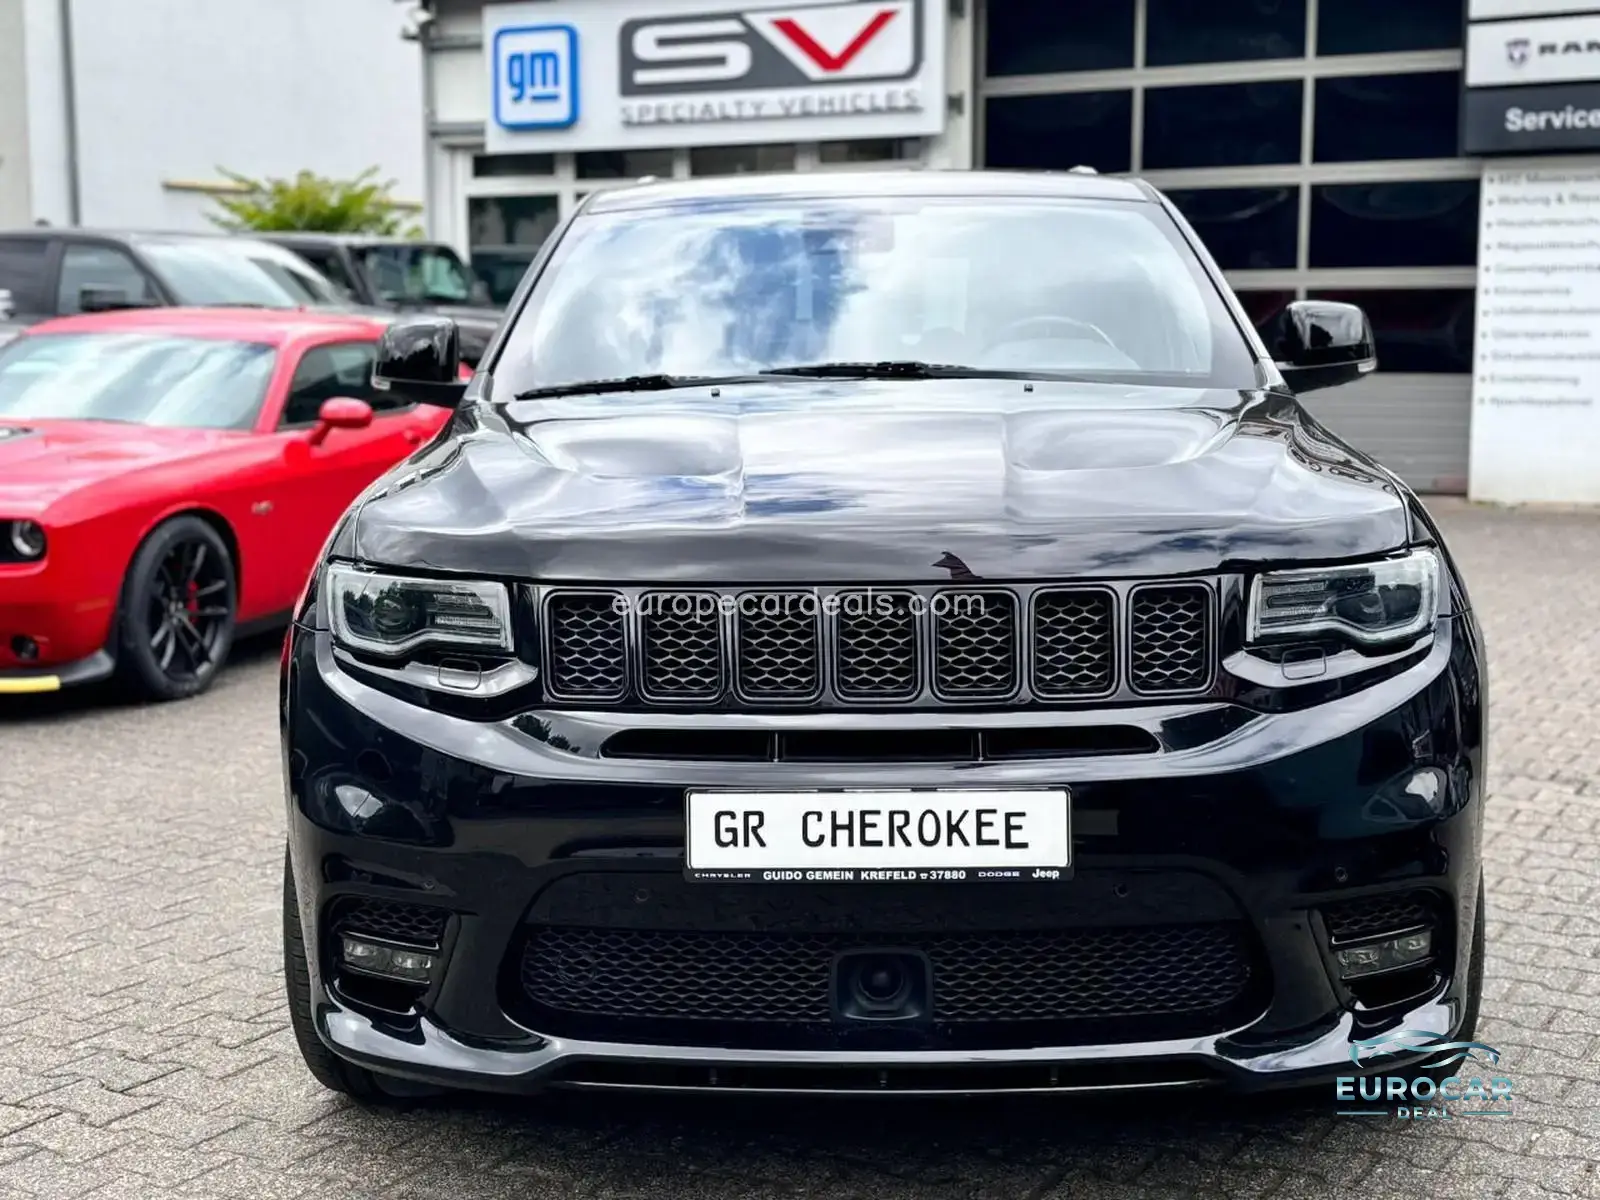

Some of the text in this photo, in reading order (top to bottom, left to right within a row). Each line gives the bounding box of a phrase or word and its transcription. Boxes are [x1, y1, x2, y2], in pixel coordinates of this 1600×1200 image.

[632, 9, 901, 85] SV
[507, 51, 560, 101] gm
[620, 89, 924, 126] SPECIALTY VEHICLES
[713, 809, 1029, 849] GR CHEROKEE
[763, 870, 966, 881] GUIDO GEMEIN KREFELD 37880
[1032, 868, 1060, 880] Jeep
